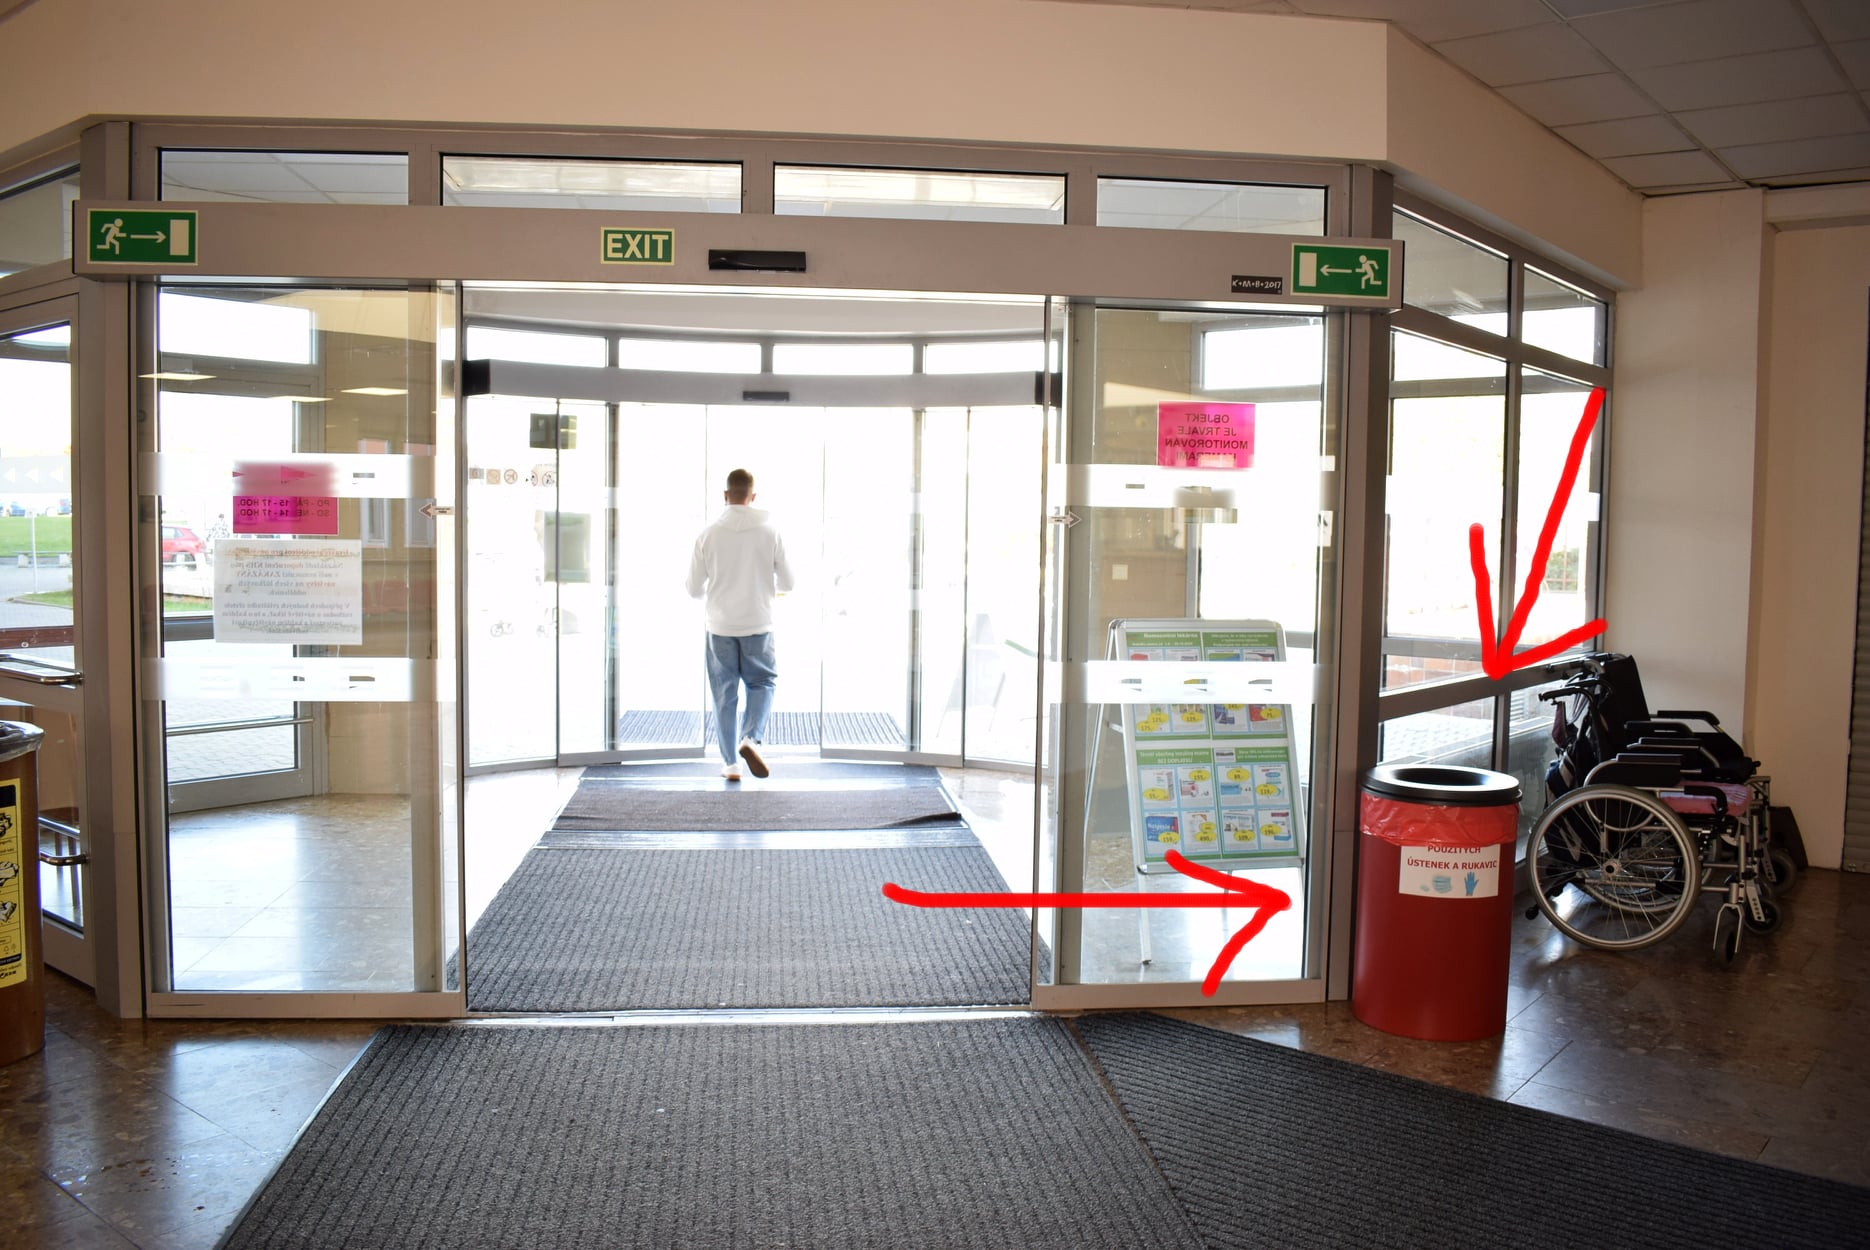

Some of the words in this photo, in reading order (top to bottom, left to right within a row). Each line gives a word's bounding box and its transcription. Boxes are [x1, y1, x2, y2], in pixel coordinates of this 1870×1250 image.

[607, 233, 669, 259] EXIT
[1407, 856, 1450, 869] ÚSTENEK
[1461, 860, 1498, 870] RUKAVIC
